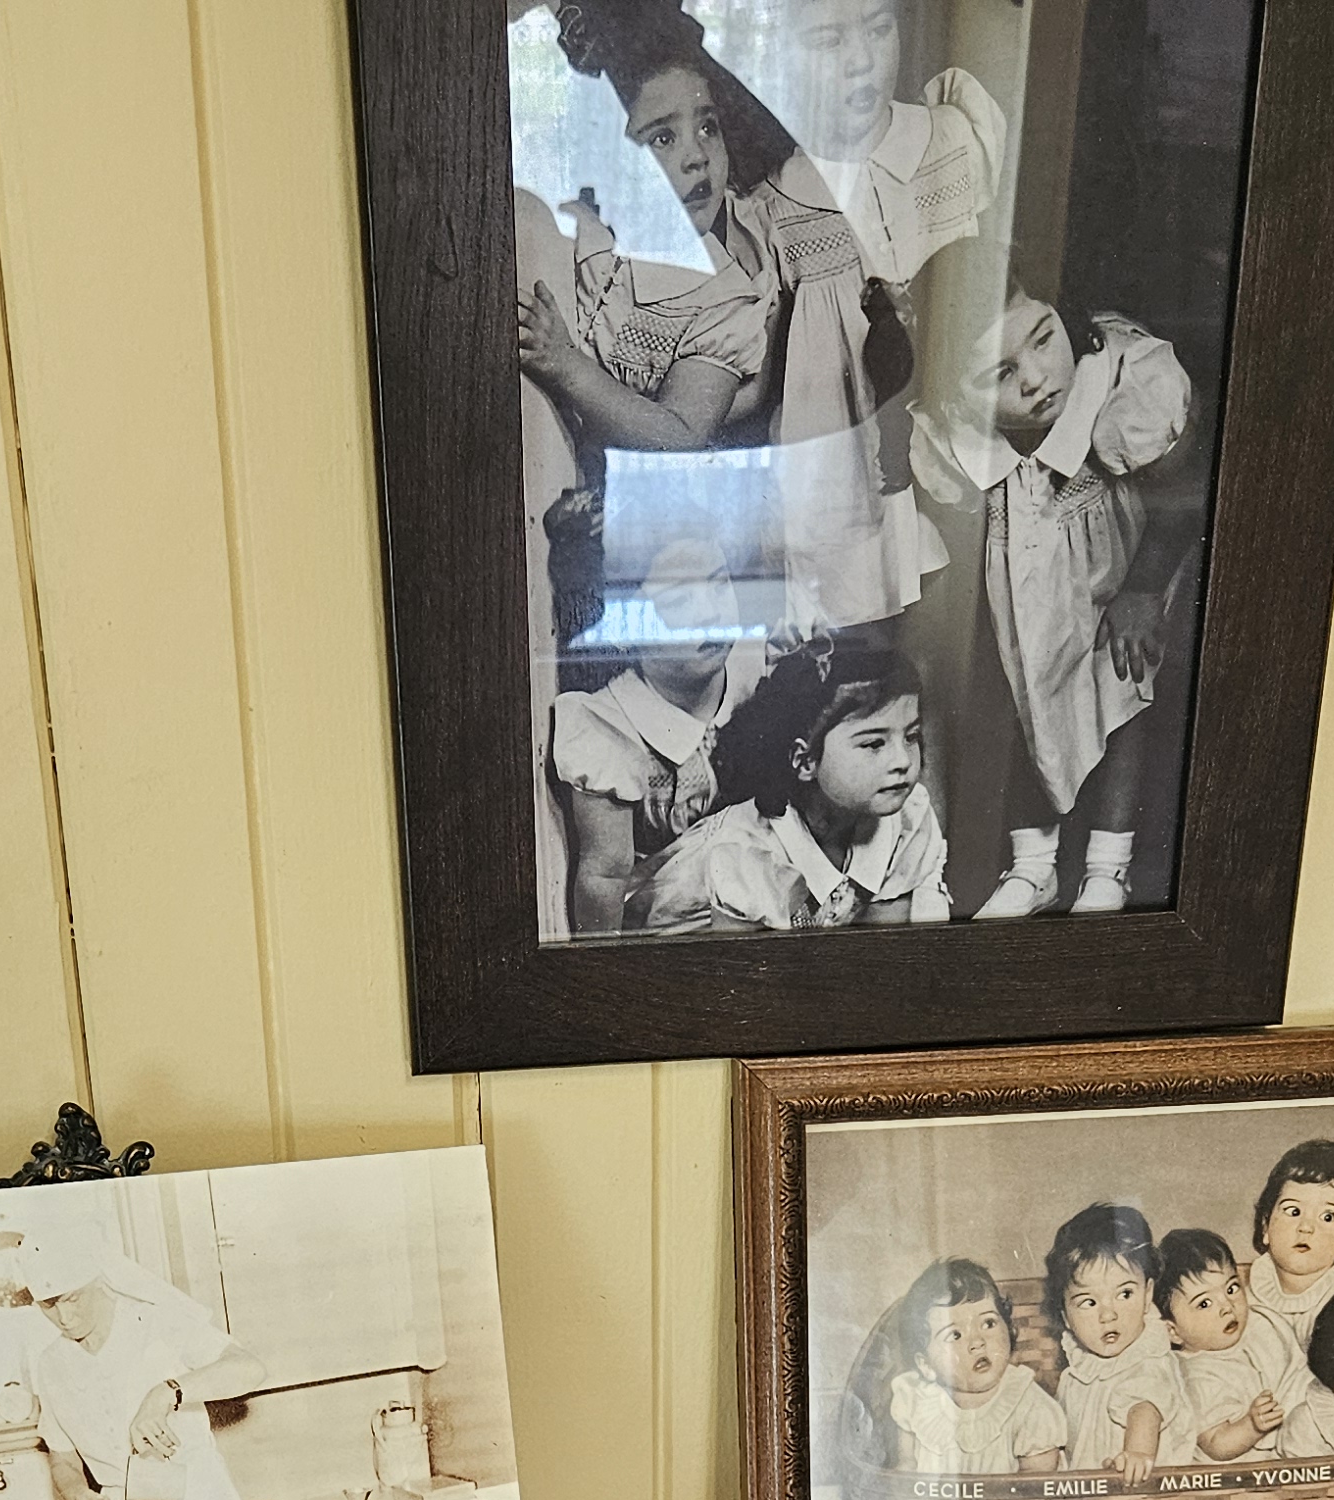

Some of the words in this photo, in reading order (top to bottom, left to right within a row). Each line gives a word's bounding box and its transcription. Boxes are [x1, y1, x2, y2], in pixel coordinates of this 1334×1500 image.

[913, 1480, 984, 1499] CECILE
[1043, 1479, 1108, 1496] EMILIE
[1159, 1473, 1222, 1491] MARIE
[1252, 1465, 1331, 1486] YVONNE
